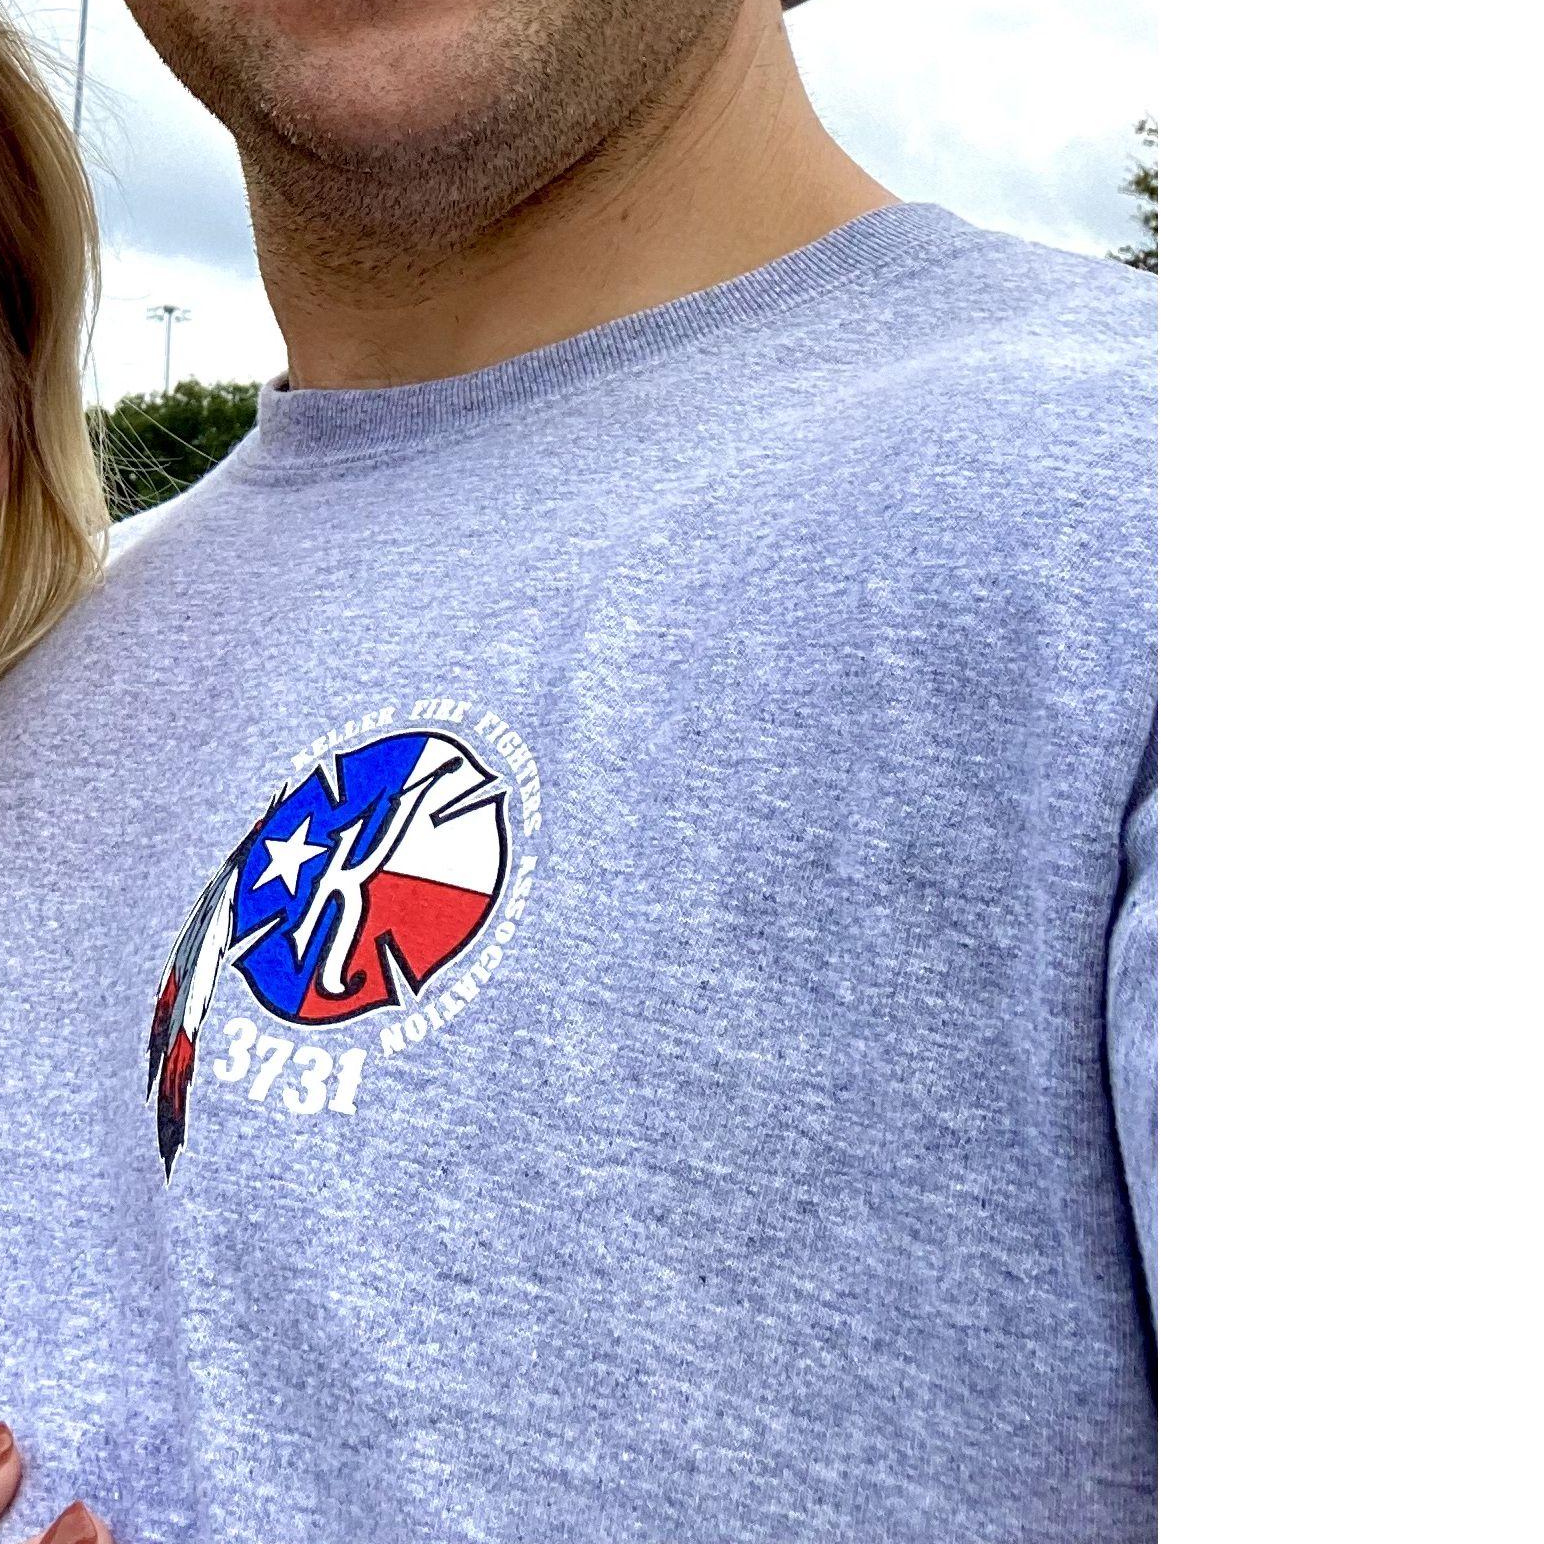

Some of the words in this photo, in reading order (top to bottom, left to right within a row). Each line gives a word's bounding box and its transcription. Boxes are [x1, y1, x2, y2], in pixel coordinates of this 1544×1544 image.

[290, 707, 396, 772] KELLER
[409, 698, 472, 723] FIRE
[474, 710, 542, 838] FIGHTERS
[378, 854, 539, 1057] ASSOCIATION
[213, 1016, 368, 1116] 3731
